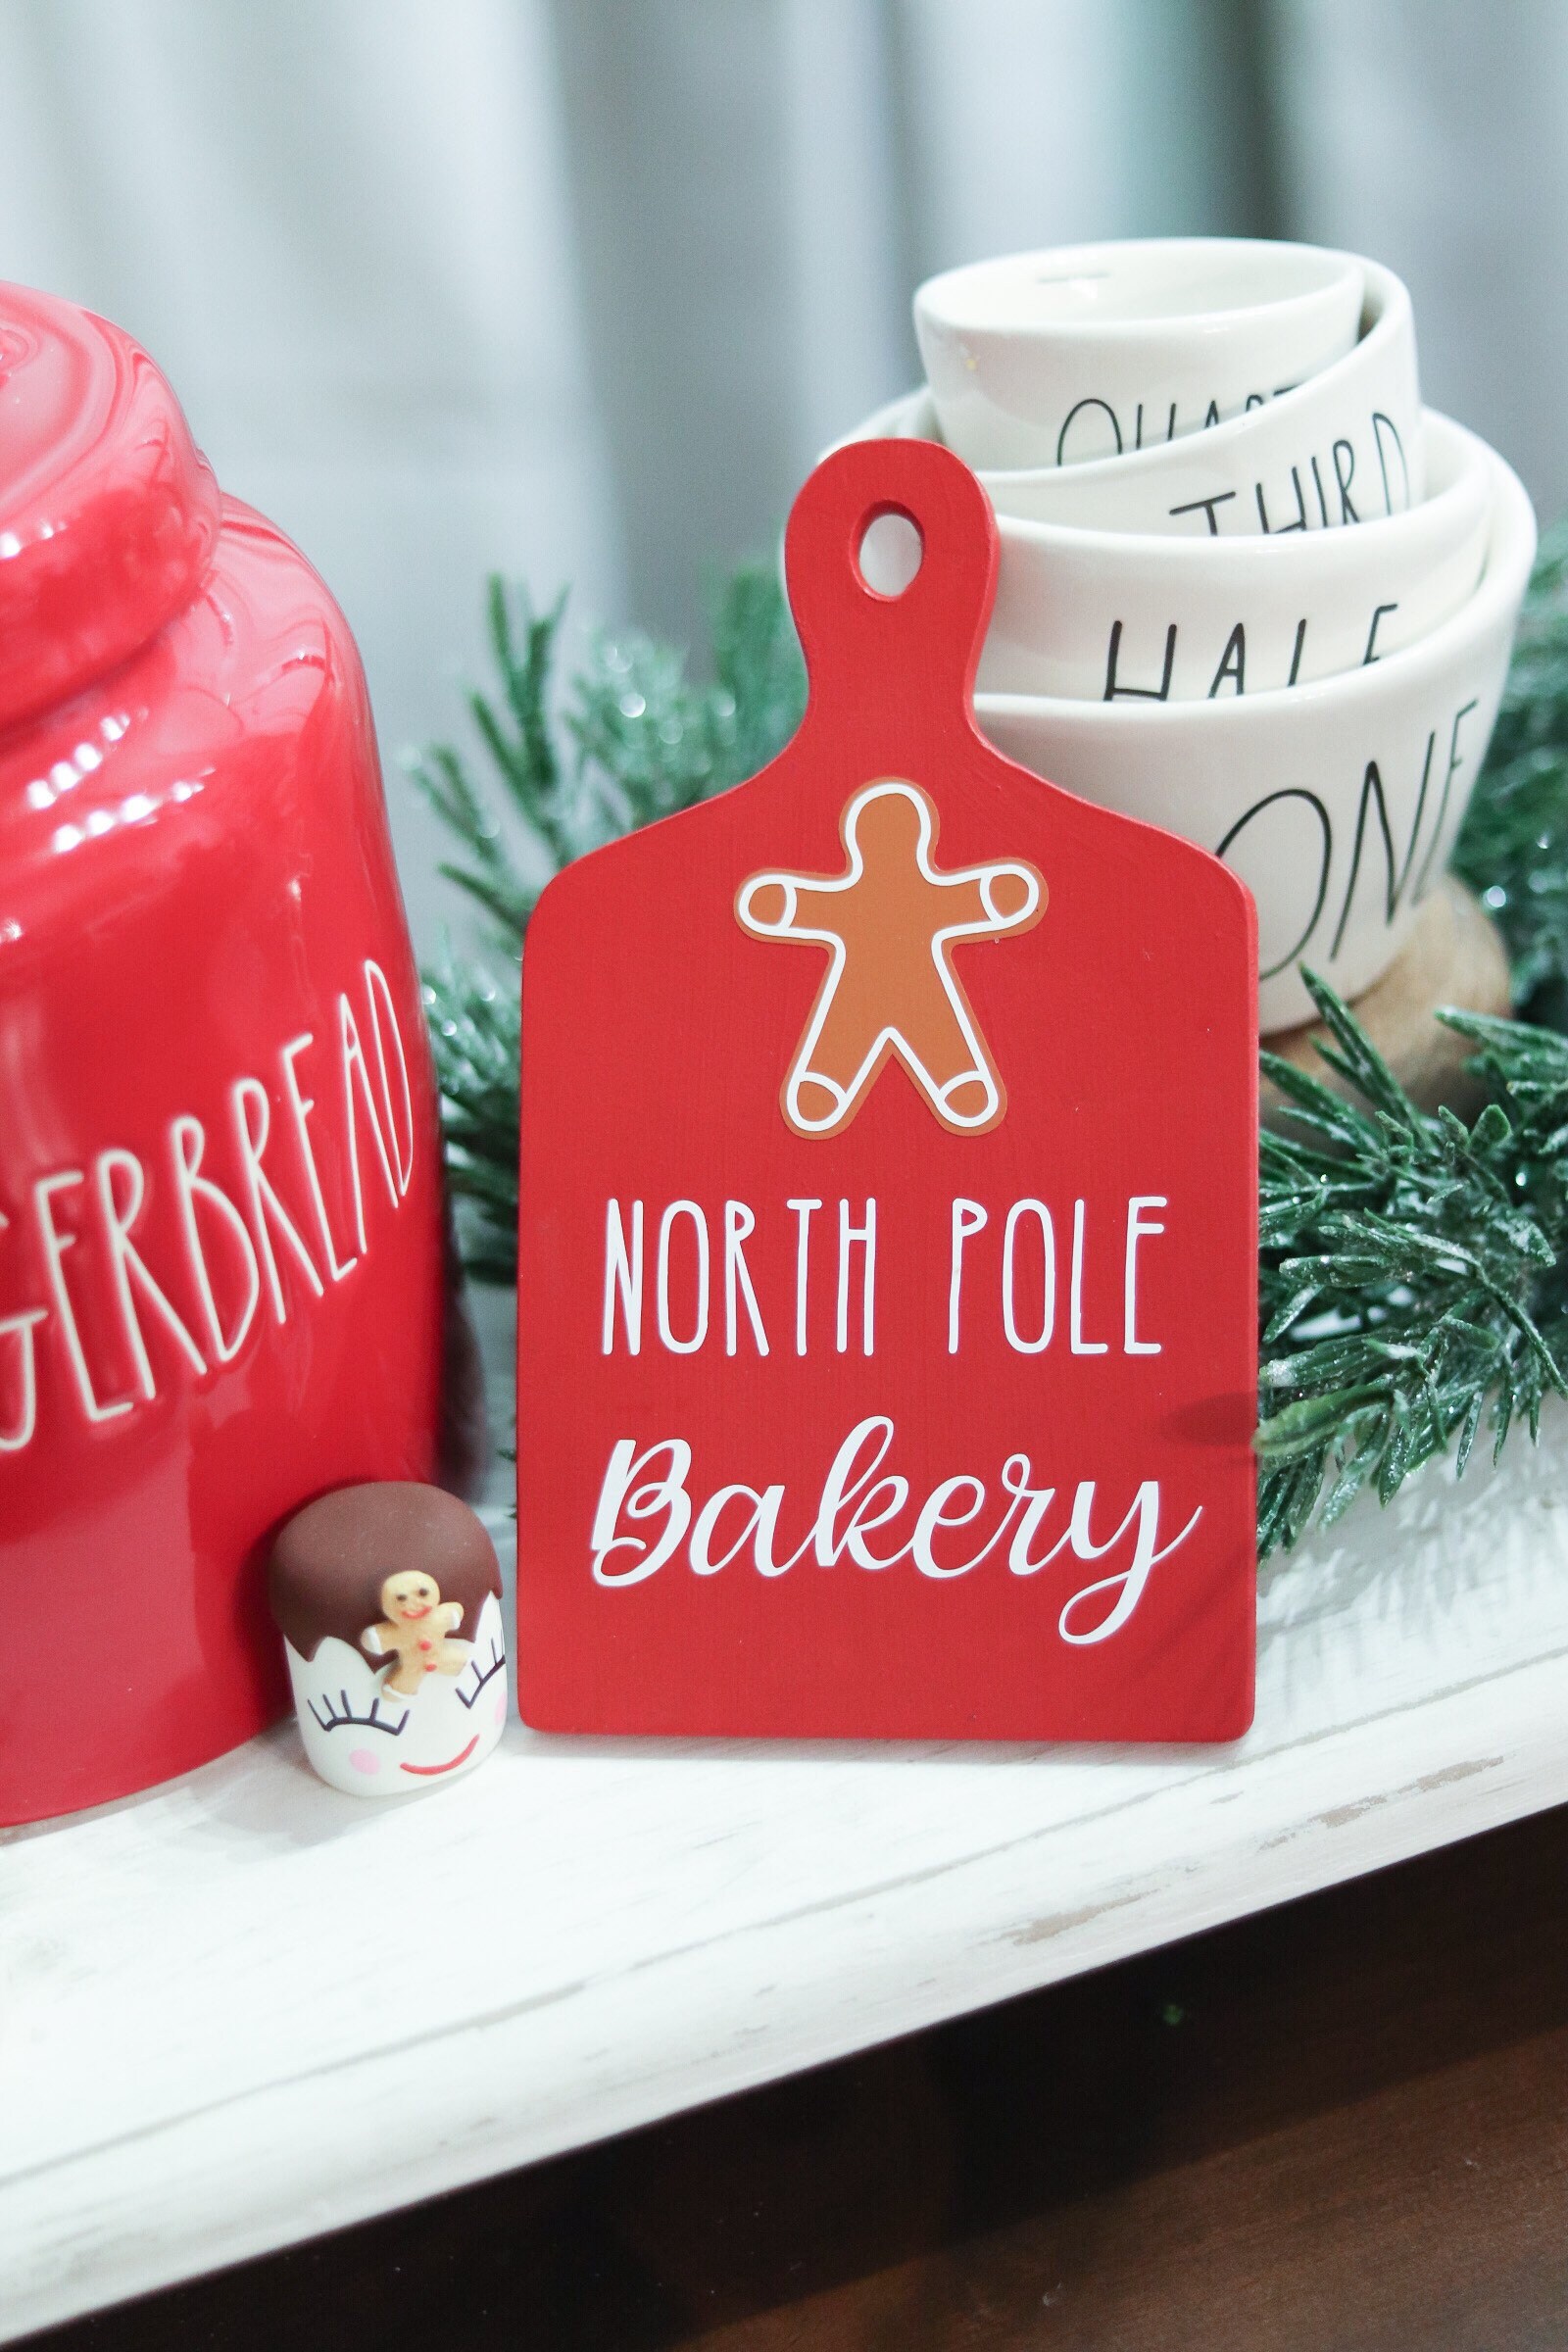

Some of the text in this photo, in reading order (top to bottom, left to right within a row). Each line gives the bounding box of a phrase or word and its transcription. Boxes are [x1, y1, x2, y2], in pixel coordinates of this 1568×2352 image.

[600, 1195, 1169, 1357] NORTH POLE
[589, 1415, 1204, 1646] Bakery
